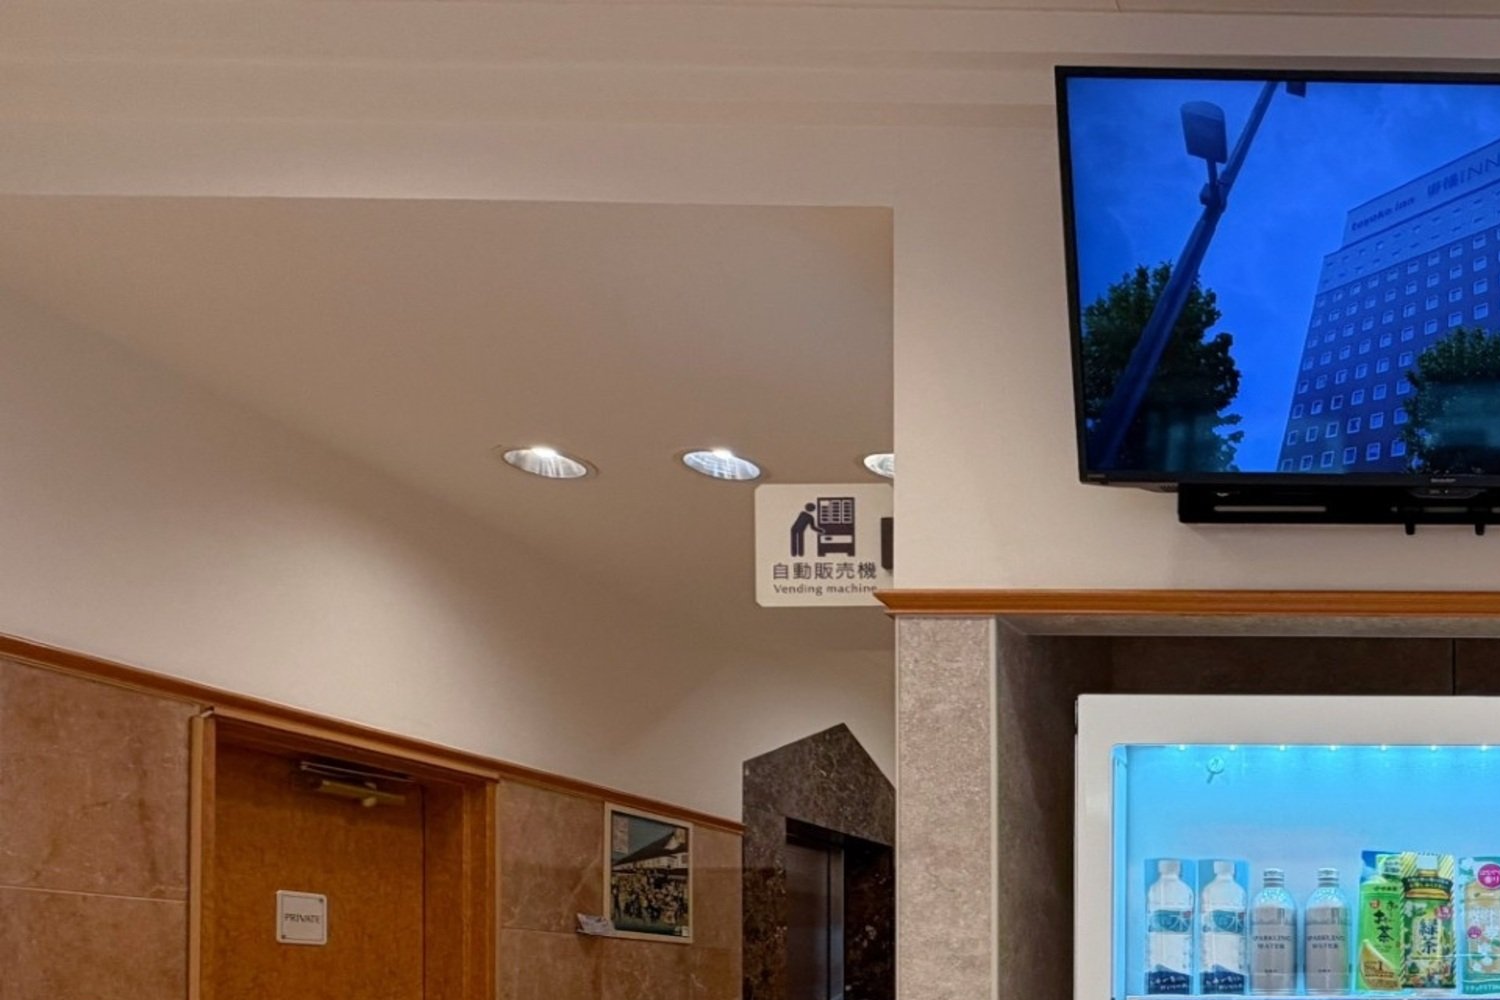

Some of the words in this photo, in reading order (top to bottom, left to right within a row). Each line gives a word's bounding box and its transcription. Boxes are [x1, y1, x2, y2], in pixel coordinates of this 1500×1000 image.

[773, 562, 877, 580] 自動販売機
[773, 584, 823, 596] Vending
[826, 584, 877, 594] machine
